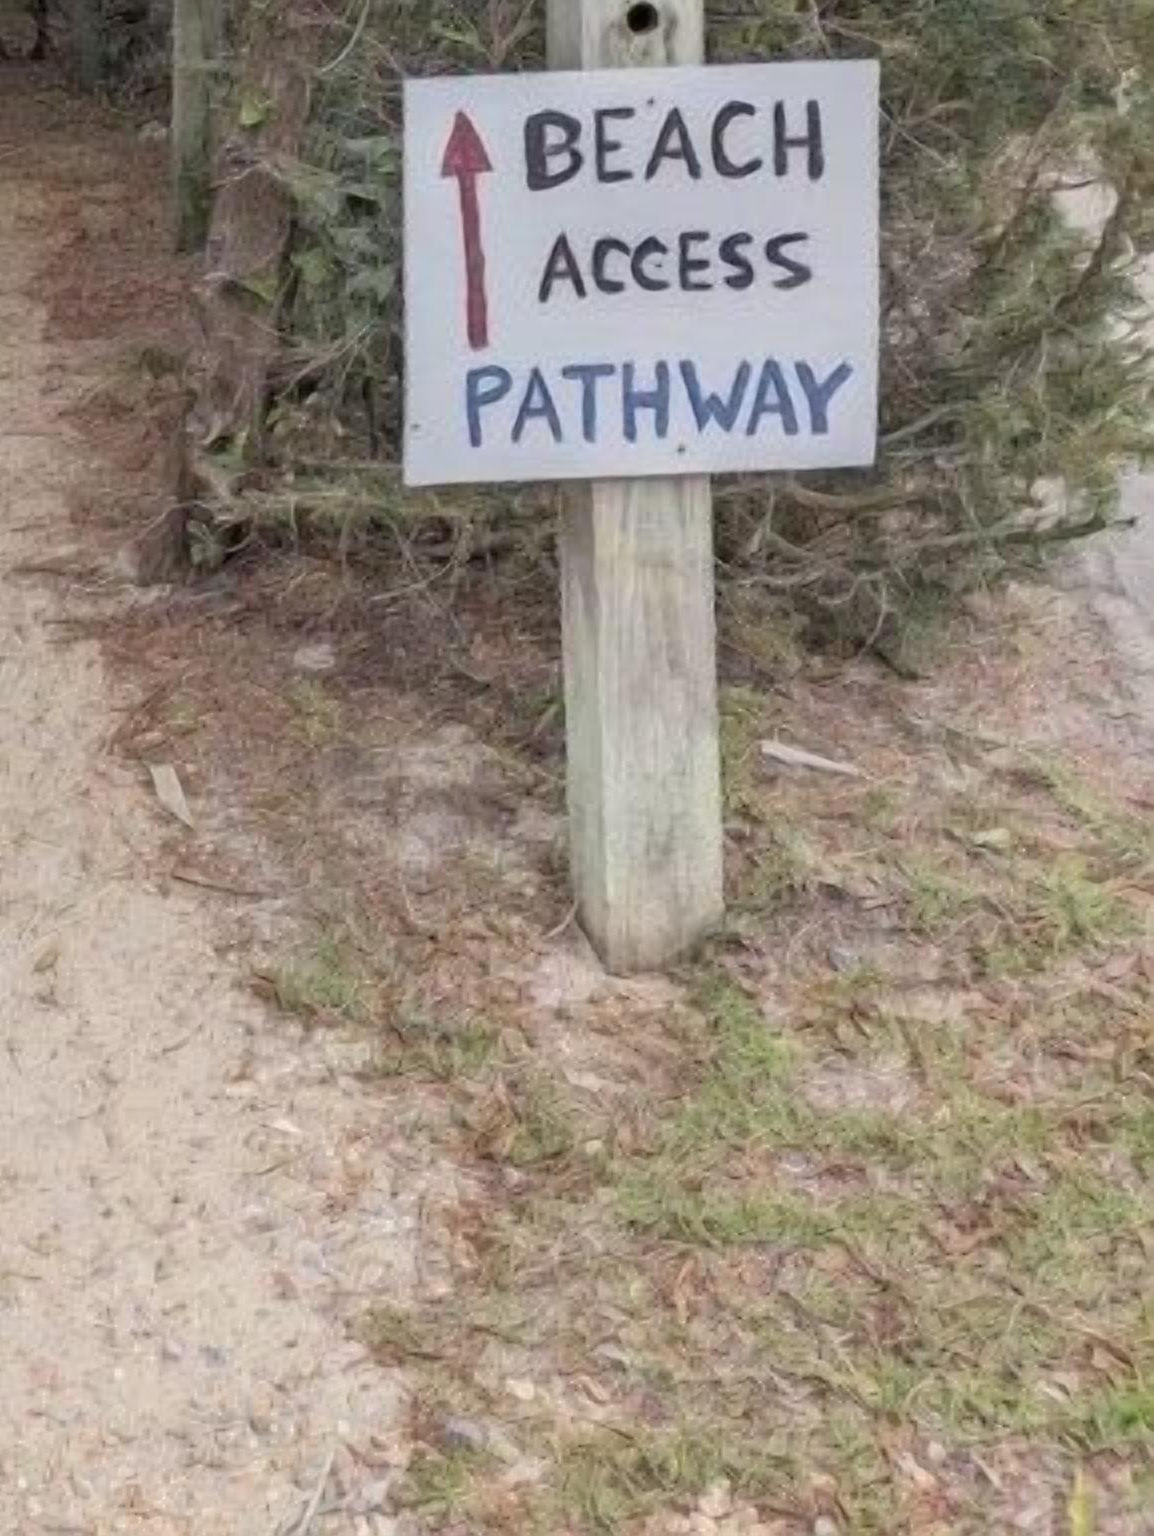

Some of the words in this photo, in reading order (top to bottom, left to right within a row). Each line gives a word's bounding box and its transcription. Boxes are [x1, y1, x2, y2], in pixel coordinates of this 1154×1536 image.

[523, 99, 825, 191] BEACH
[538, 231, 812, 303] ACCESS
[465, 359, 853, 448] PATHWAY
